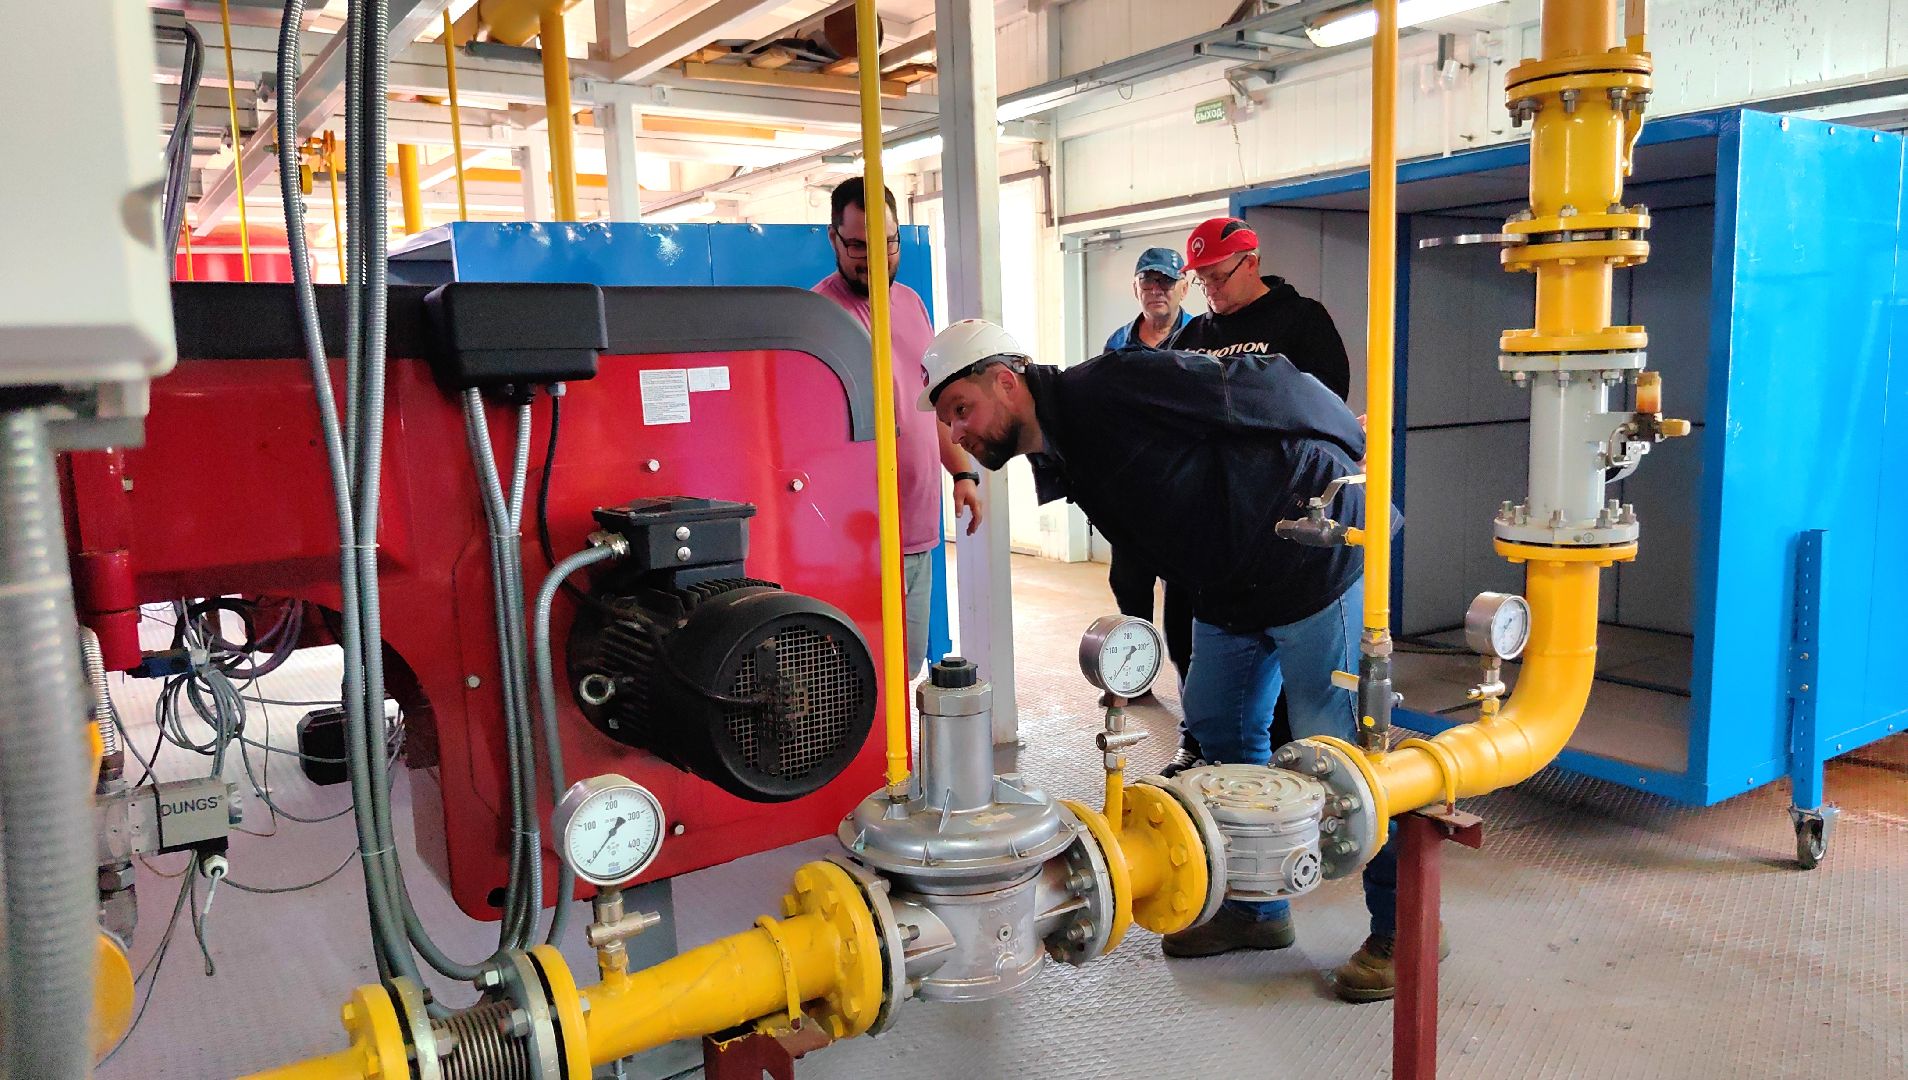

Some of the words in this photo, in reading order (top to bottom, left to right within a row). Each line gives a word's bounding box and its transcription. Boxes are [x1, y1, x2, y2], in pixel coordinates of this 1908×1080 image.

[605, 800, 618, 810] 200
[628, 811, 640, 821] 300
[584, 821, 597, 831] 100
[628, 838, 640, 848] 400
